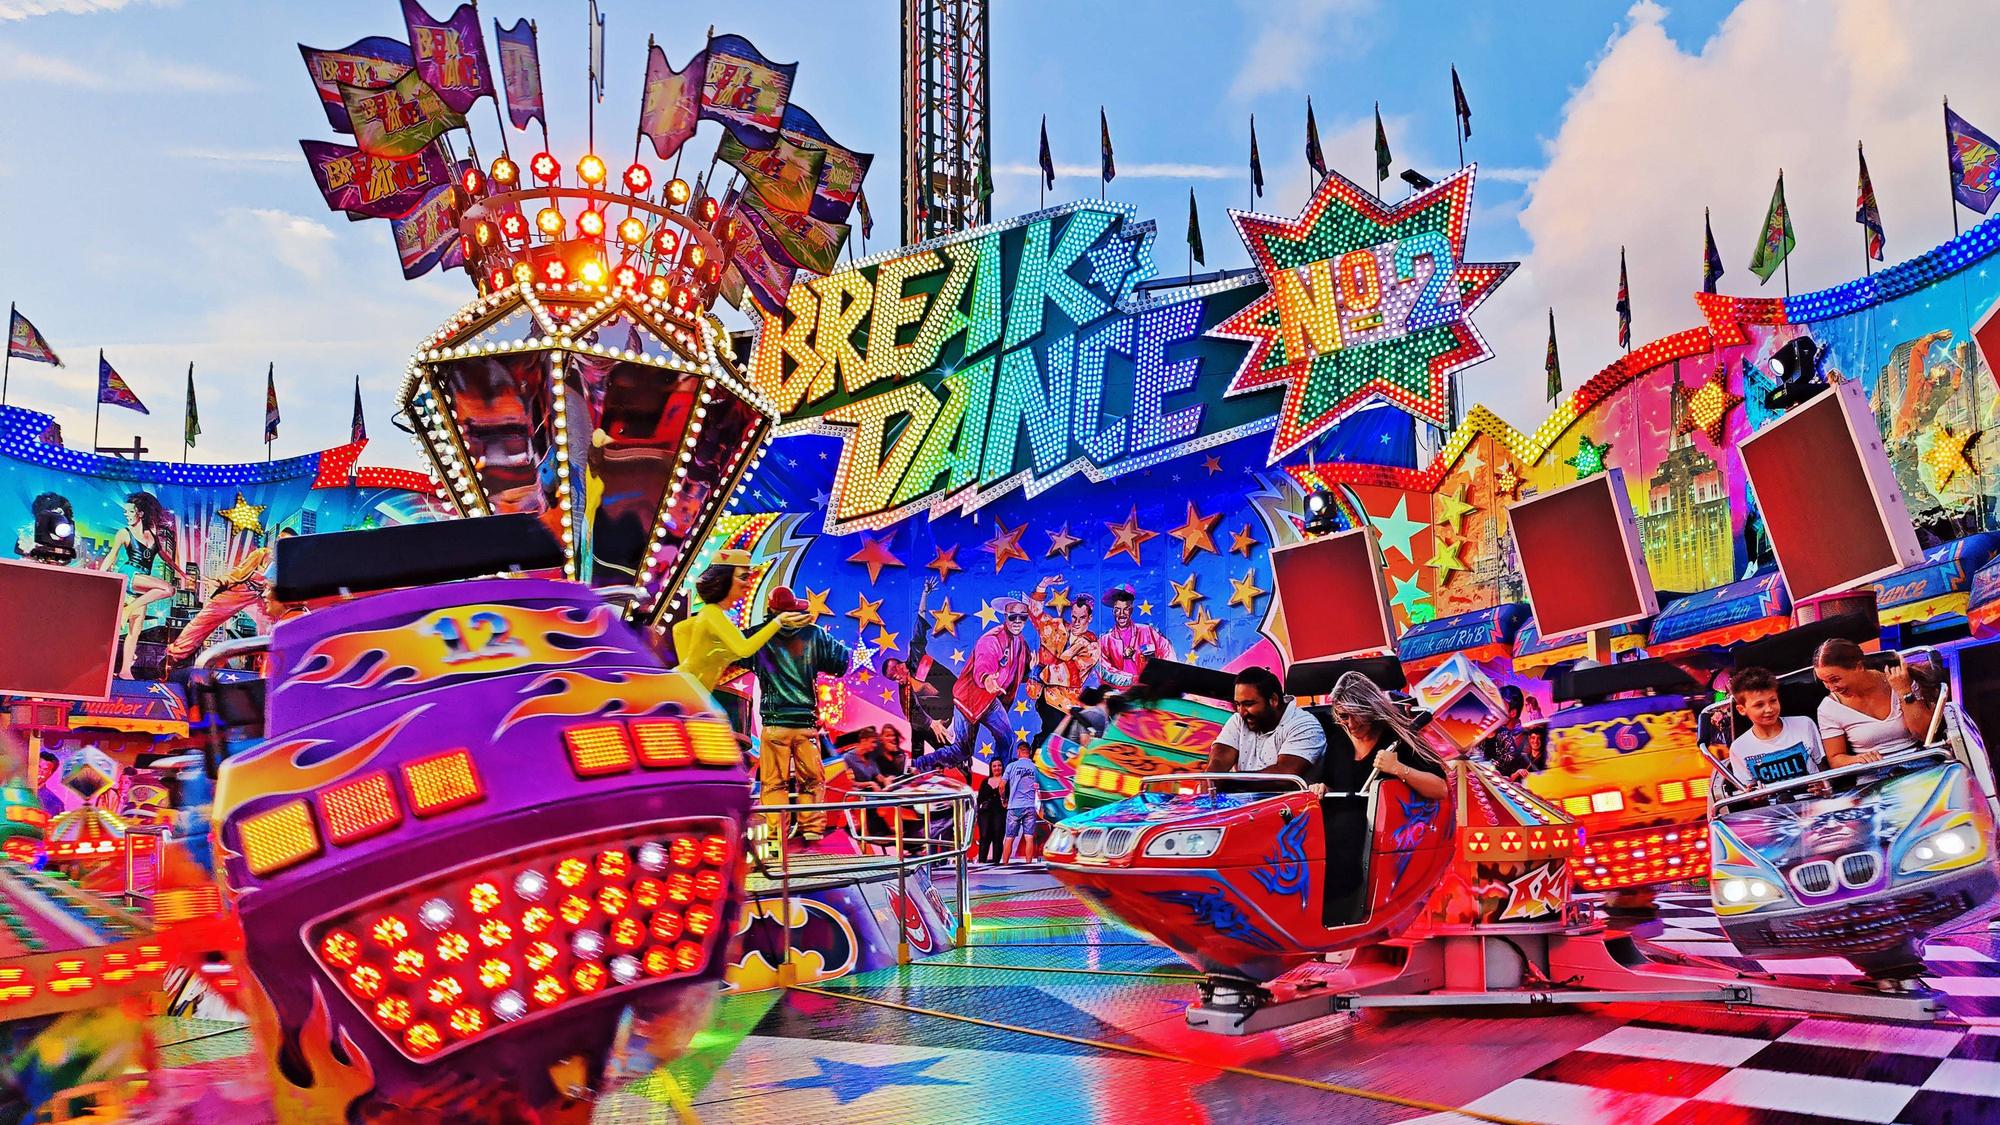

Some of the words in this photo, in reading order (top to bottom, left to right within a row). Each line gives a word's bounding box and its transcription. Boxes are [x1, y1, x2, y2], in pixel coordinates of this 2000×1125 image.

[1393, 231, 1462, 333] 2
[749, 209, 1119, 415] BREAK
[822, 300, 1204, 520] DANCE
[1874, 579, 1928, 605] Dance
[431, 611, 532, 665] 12
[1408, 637, 1435, 656] Funk
[1435, 630, 1459, 649] and
[80, 697, 142, 716] number
[1615, 725, 1638, 750] 6
[1760, 758, 1803, 780] CHILL
